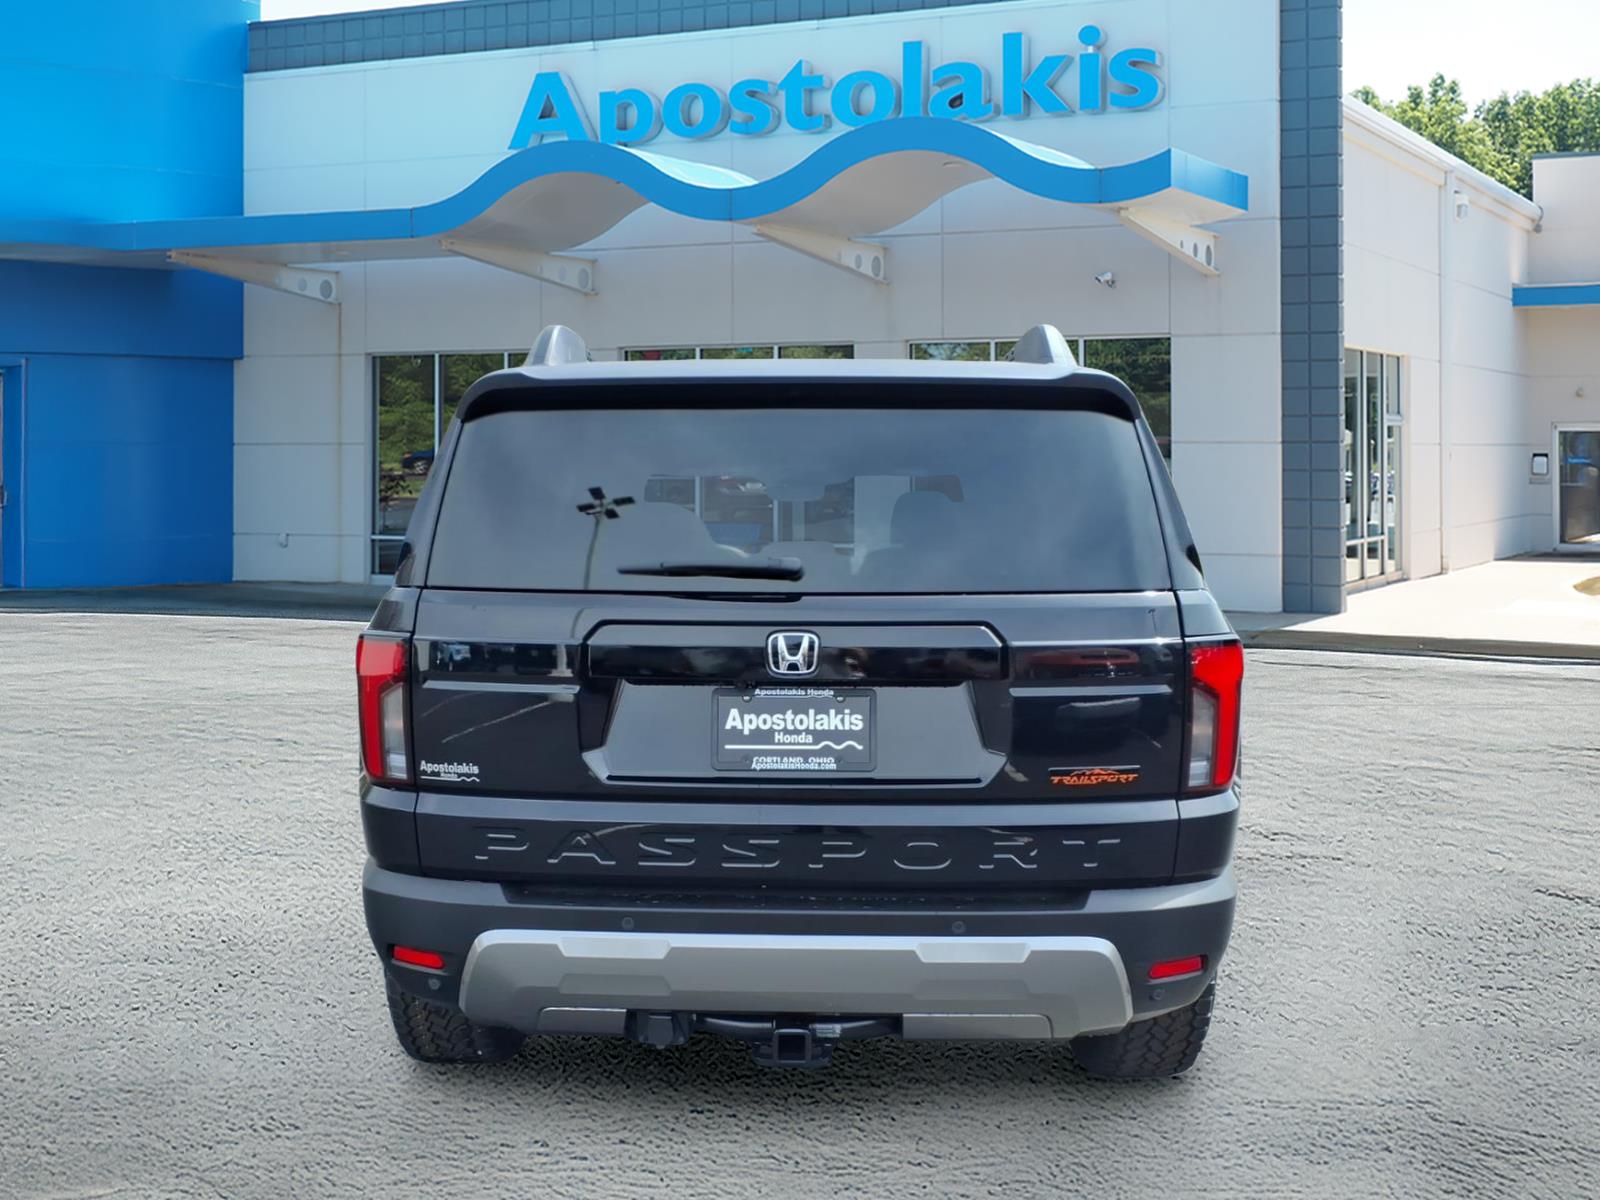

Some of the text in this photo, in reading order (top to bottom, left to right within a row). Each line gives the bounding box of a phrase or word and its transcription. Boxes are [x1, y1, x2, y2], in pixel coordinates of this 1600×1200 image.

[508, 25, 1166, 150] Apostolakis
[725, 708, 864, 735] Apostolakis
[774, 731, 813, 744] Honda
[420, 760, 479, 774] Apostolakis
[1050, 774, 1138, 785] TRAILSPORT
[474, 827, 1121, 869] PASSPORT
